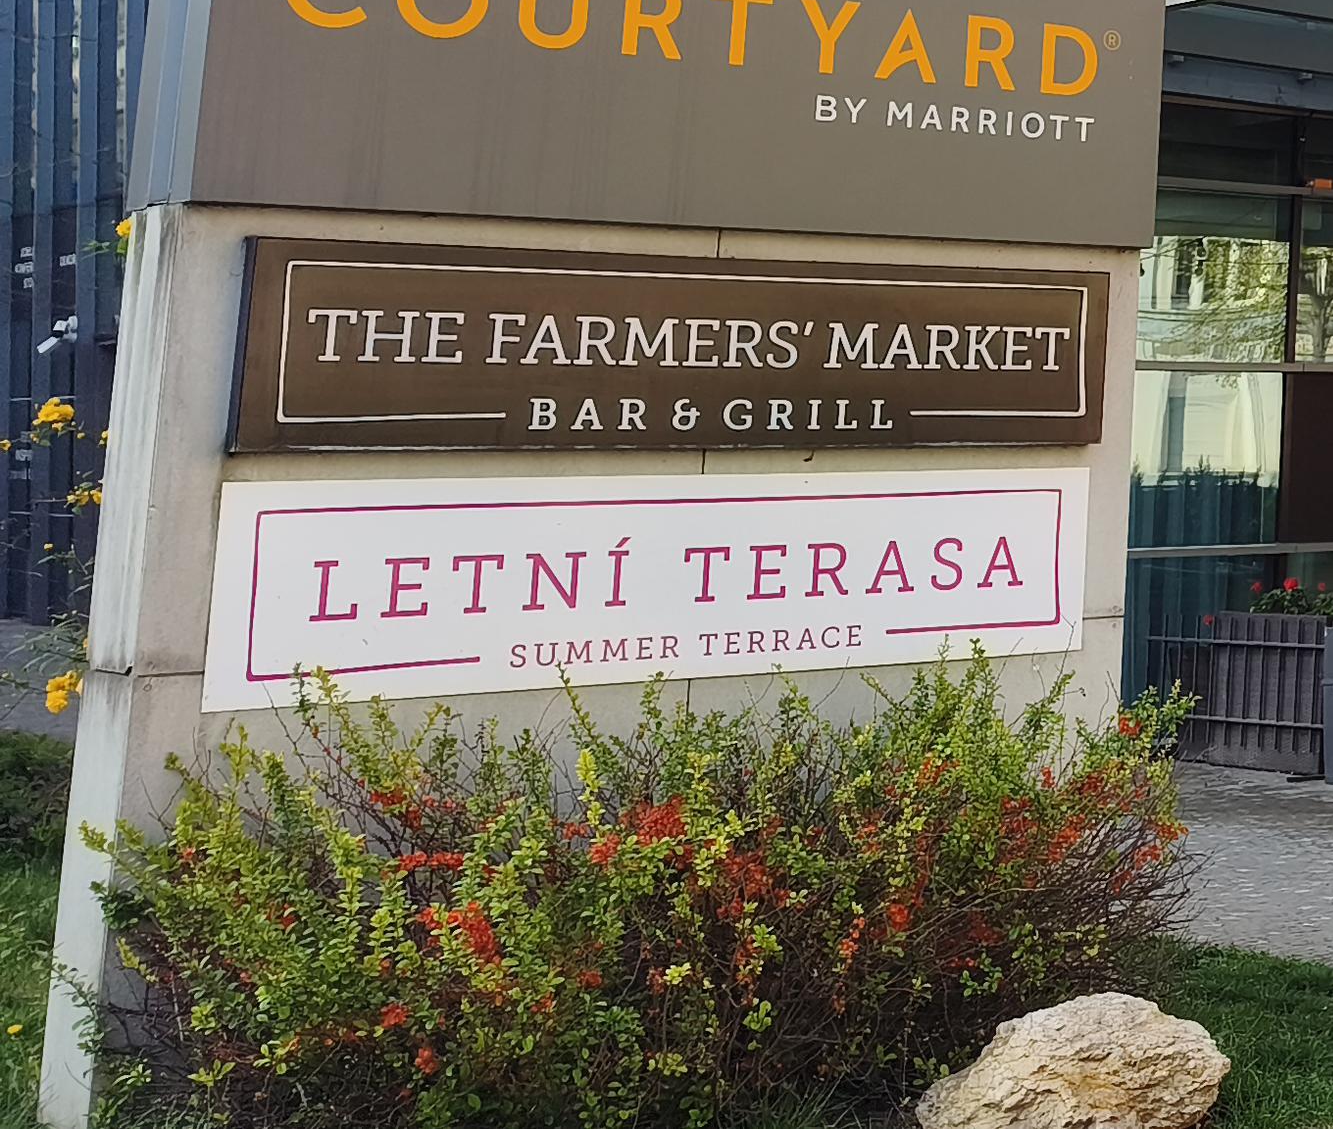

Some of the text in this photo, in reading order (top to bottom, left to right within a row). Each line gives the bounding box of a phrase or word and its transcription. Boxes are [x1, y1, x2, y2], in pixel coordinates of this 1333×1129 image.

[813, 94, 1096, 143] BY MARRIOTT
[307, 306, 464, 366] THE
[823, 320, 1071, 373] MARKET
[528, 396, 897, 433] BAR & GRILL
[309, 534, 1025, 625] LETNÍ TERASA
[508, 622, 864, 671] SUMMER TERRACE
